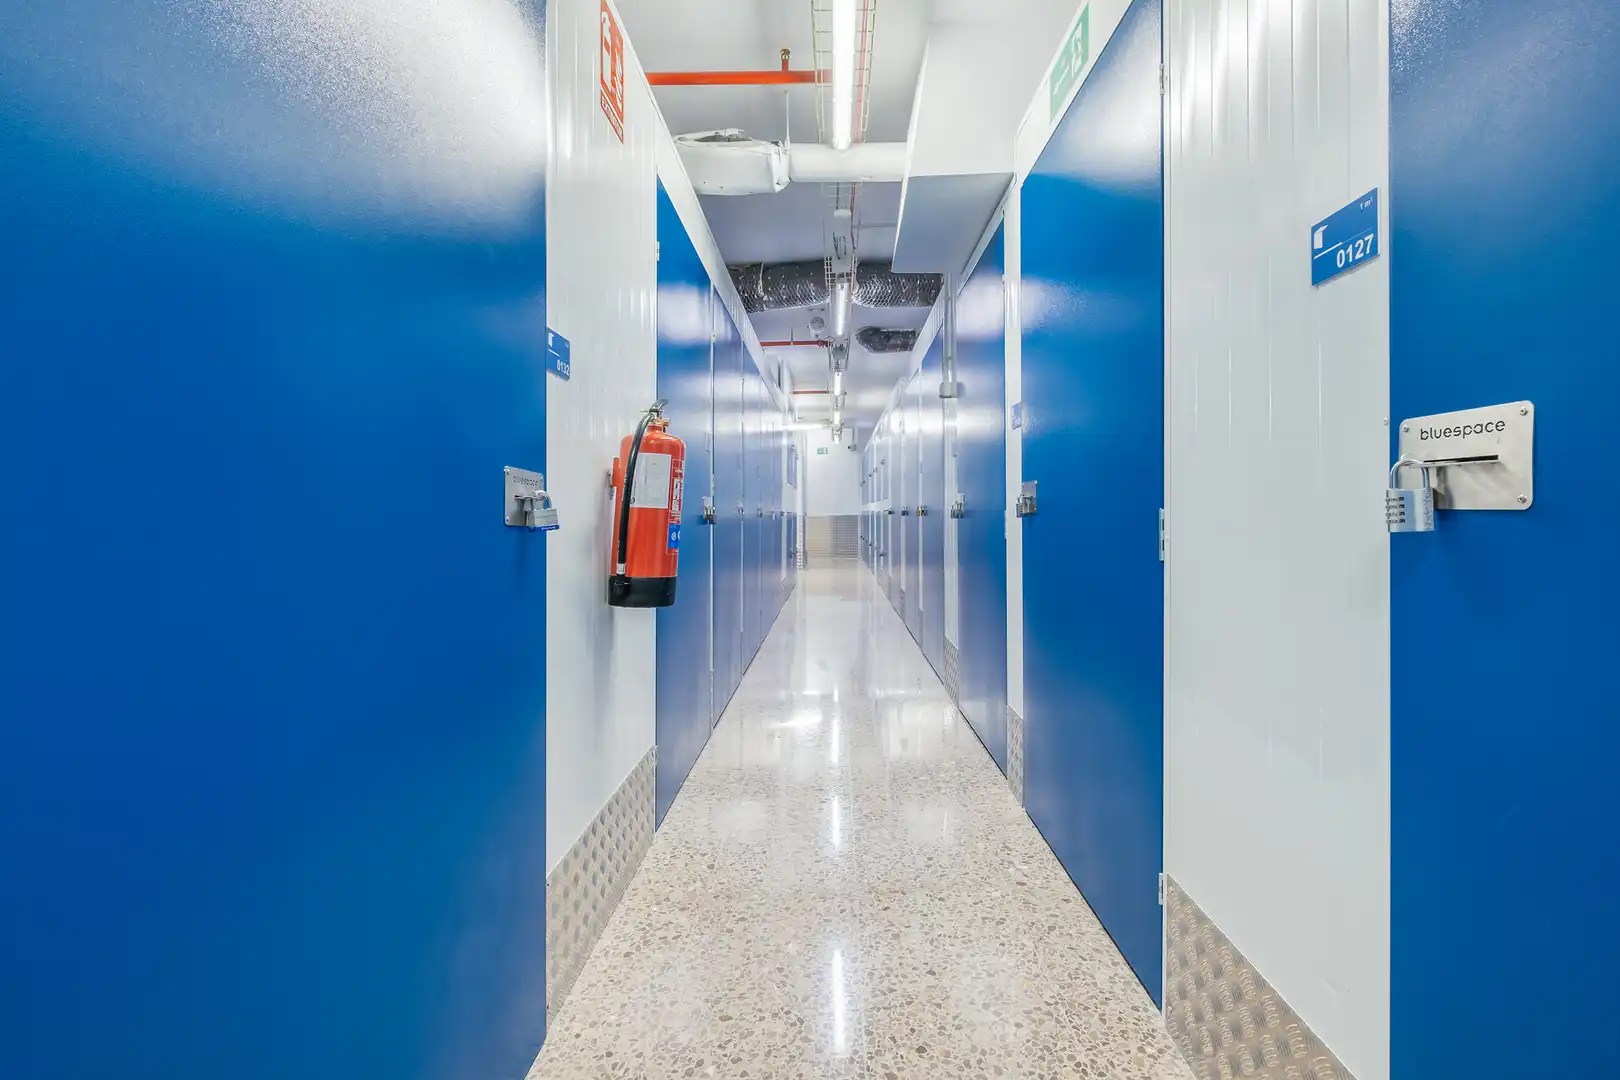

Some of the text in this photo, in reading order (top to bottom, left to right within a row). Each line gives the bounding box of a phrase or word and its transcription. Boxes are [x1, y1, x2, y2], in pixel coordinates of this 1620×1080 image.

[1336, 233, 1374, 268] 0127
[556, 359, 570, 376] 0132
[1420, 420, 1506, 441] bluespace
